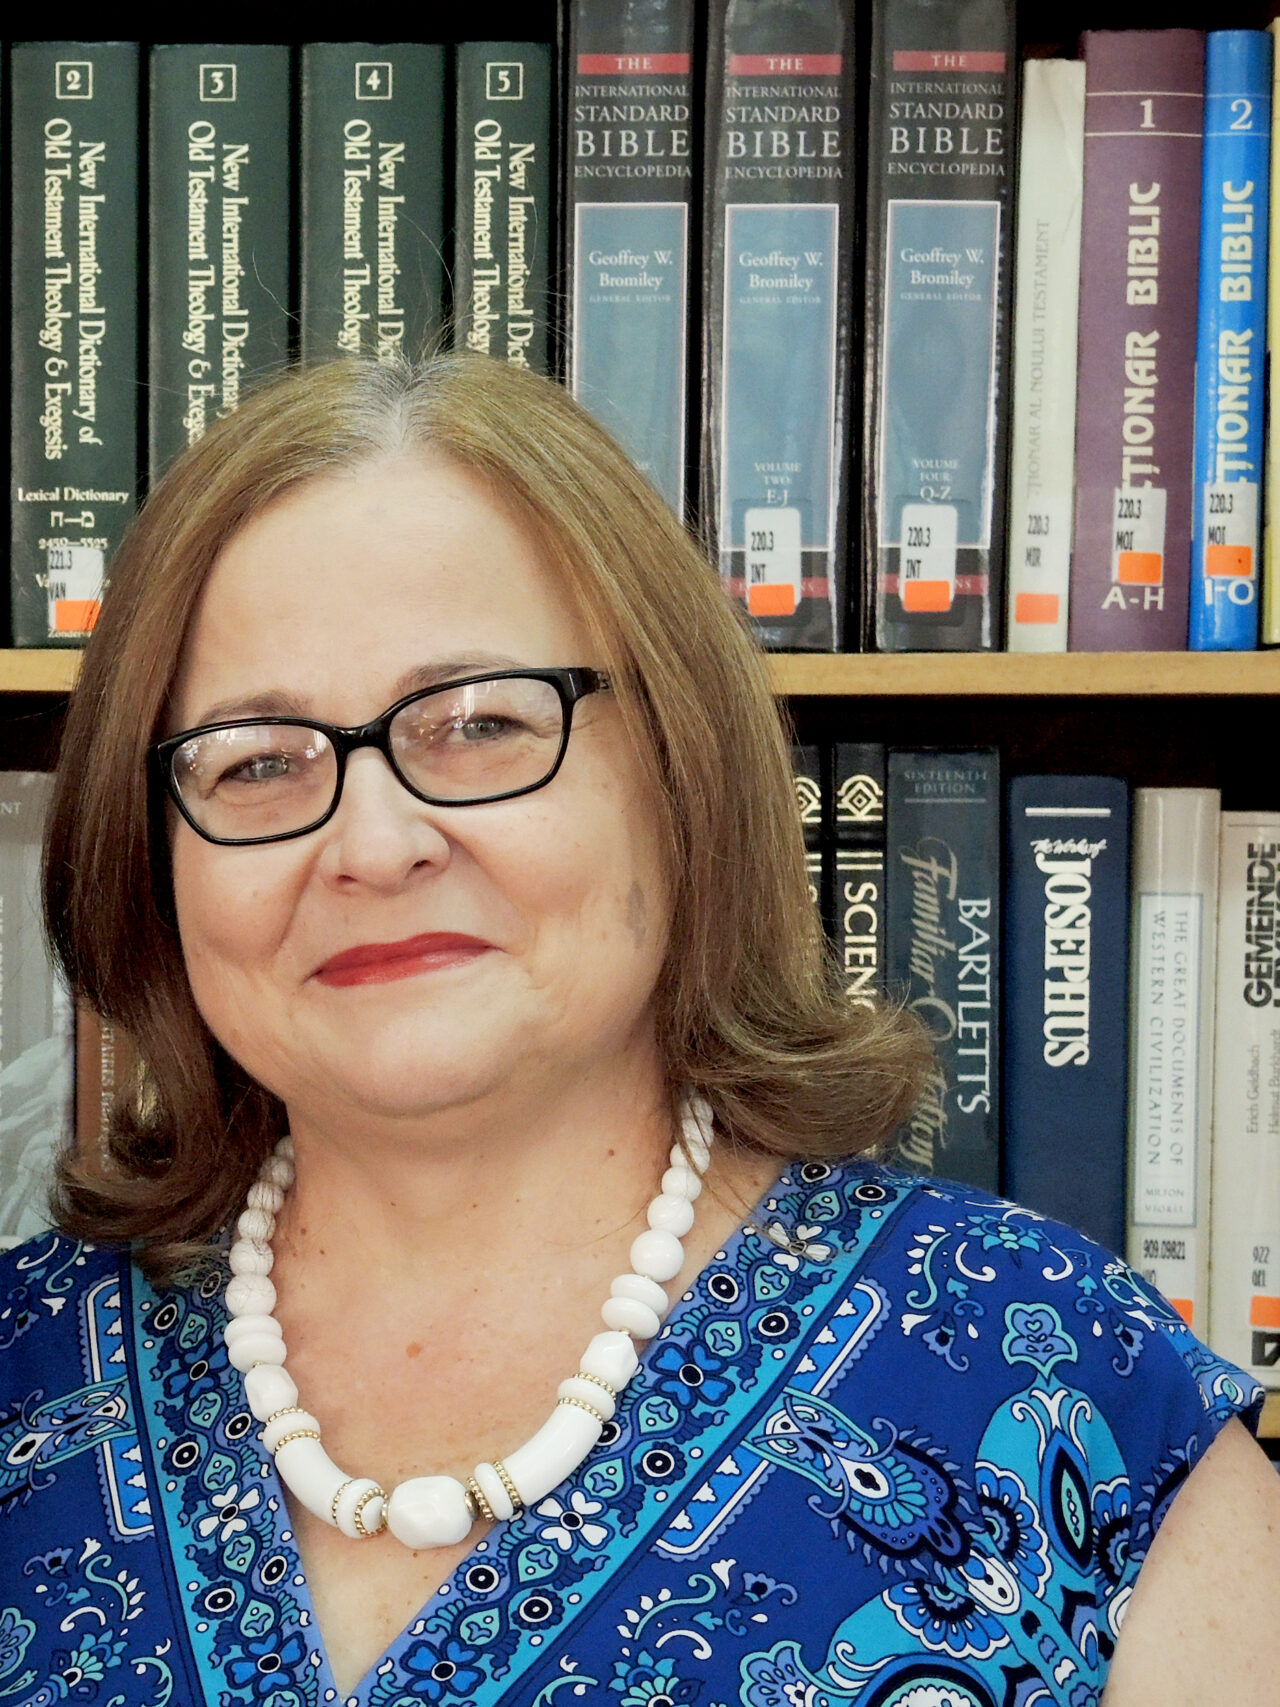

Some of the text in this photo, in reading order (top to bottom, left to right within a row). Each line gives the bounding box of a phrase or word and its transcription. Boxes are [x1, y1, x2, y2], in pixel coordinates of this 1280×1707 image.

[616, 58, 652, 70] THE
[766, 58, 803, 71] THE
[931, 54, 967, 67] THE
[66, 70, 82, 91] 2
[211, 72, 224, 94] 3
[366, 71, 380, 91] 4
[497, 71, 510, 92] 5
[890, 82, 1004, 95] INTERNATIONAL
[576, 85, 689, 97] INTERNATIONAL
[726, 86, 839, 98] INTERNATIONAL
[575, 105, 689, 122] STANDARD
[726, 106, 840, 123] STANDARD
[890, 103, 1004, 119] STANDARD
[1140, 99, 1156, 128] 1
[1230, 99, 1253, 130] 2
[576, 130, 690, 157] BIBLE
[727, 131, 840, 158] BIBLE
[890, 127, 1004, 155] BIBLE
[575, 165, 692, 178] ENCYCLOPEDIA
[725, 166, 843, 179] ENCYCLOPEDIA
[887, 162, 1005, 176] ENCYCLOPEDIA
[222, 143, 250, 316] New International
[337, 119, 371, 353] Old Testament Theology
[378, 142, 405, 315] New International
[467, 119, 502, 354] Old Testament Theology
[508, 142, 535, 316] New International
[182, 121, 215, 379] Old Testament Theology &
[1126, 181, 1161, 305] BIBLIC
[1220, 180, 1254, 302] BIBLIC
[589, 250, 672, 268] Geoffrey W.
[739, 251, 823, 270] Geoffrey W.
[901, 248, 984, 266] Geoffrey W.
[39, 118, 72, 460] Old Testament Theology & Exegesis
[599, 273, 663, 291] Bromiley
[749, 273, 813, 291] Bromiley
[910, 270, 975, 288] Bromiley
[72, 141, 106, 446] New International Dictionary of
[1030, 219, 1050, 420] AL NOULUI TESTAMENT
[755, 462, 801, 472] VOLUME
[913, 459, 959, 469] VOLUME
[18, 487, 129, 504] Lexical Dictionary
[1209, 494, 1234, 514] 220.3
[1118, 499, 1142, 519] 220.3
[1027, 515, 1049, 535] 220.3
[751, 531, 774, 551] 220.3
[908, 527, 931, 548] 220.3
[1116, 531, 1134, 551] MOI
[1208, 526, 1226, 545] MOI
[49, 550, 72, 570] 221.3
[906, 560, 922, 579] INT
[751, 564, 766, 583] INT
[904, 770, 988, 781] SIXTEENTH
[914, 783, 976, 794] EDITION
[898, 836, 958, 998] Familiar
[1243, 843, 1276, 1008] GEMEINDE
[1035, 852, 1093, 1067] JOSEPHUS
[1147, 911, 1166, 1165] WESTERN CIVILIZATION
[1169, 911, 1189, 1166] THE GREAT DOCUMENTS OF
[1246, 1104, 1259, 1135] Erich
